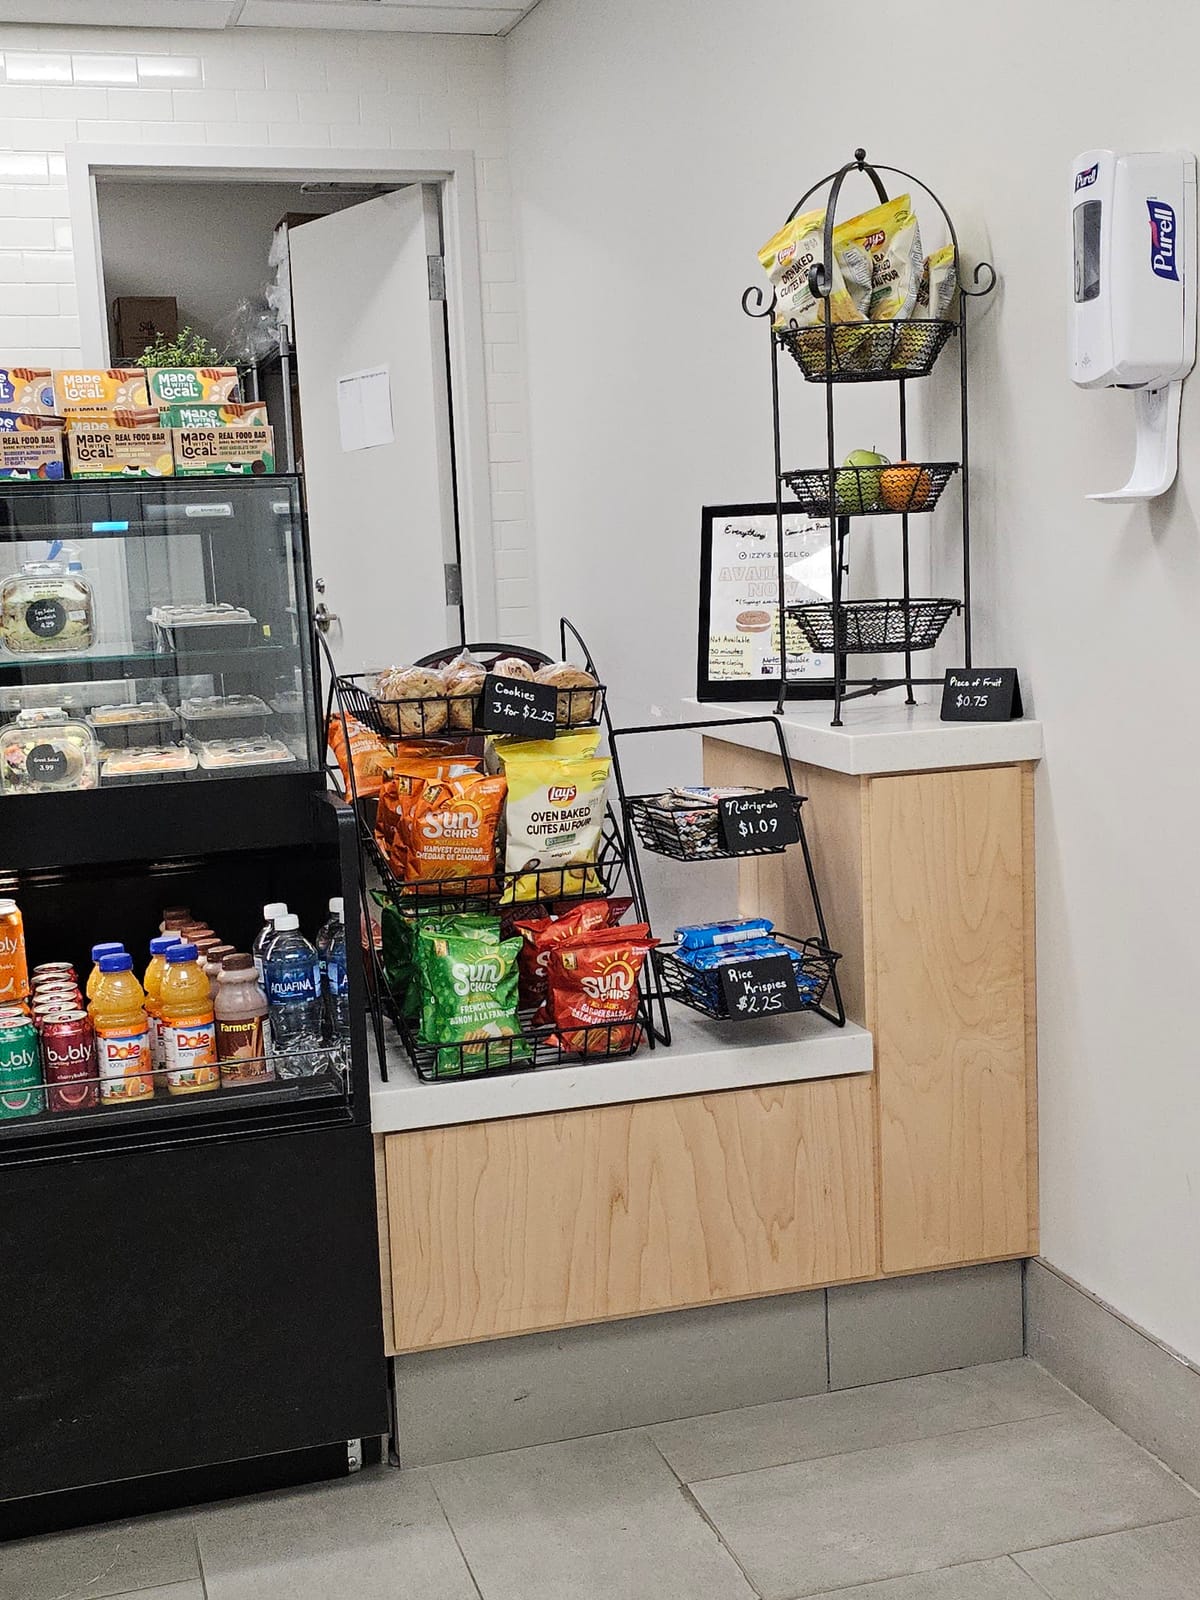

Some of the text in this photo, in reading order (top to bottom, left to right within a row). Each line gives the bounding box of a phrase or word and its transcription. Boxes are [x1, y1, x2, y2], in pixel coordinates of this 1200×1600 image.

[864, 231, 885, 248] ays
[1153, 207, 1173, 271] Purell
[782, 253, 814, 284] OVEN BAKED
[3, 435, 56, 445] REAL FOOD BAR
[115, 432, 166, 441] REAL FOOD BAR
[218, 431, 266, 440] REAL FOOD BAR
[724, 524, 767, 540] Everything
[720, 647, 744, 655] minutes
[971, 677, 981, 687] of
[982, 676, 1002, 688] Fruit
[495, 682, 536, 702] Cookies
[955, 693, 989, 708] $0.75
[492, 701, 502, 714] 3
[503, 704, 520, 717] for
[531, 806, 591, 823] OVEN BAKED
[724, 799, 778, 816] Nutrigrain
[422, 810, 482, 839] Sun
[526, 817, 592, 835] CUITES AU FOUR
[738, 818, 778, 838] $1.09
[443, 829, 480, 840] CHIPS
[416, 851, 446, 860] CHEDDAR
[456, 854, 490, 862] CAMPAGNE
[424, 845, 483, 854] HARVEST CHEDDAR
[452, 962, 505, 997] Sun
[727, 968, 754, 983] Rice
[271, 978, 314, 994] AQUAFINA
[470, 982, 498, 993] CHIPS
[580, 971, 634, 1000] Sun
[743, 980, 788, 995] Krispies
[600, 990, 631, 1002] CHIPS
[736, 992, 782, 1013] $2.25
[220, 1021, 257, 1033] Farmers
[177, 1032, 210, 1050] Dole
[47, 1042, 92, 1063] bubly
[107, 1042, 140, 1060] Dole
